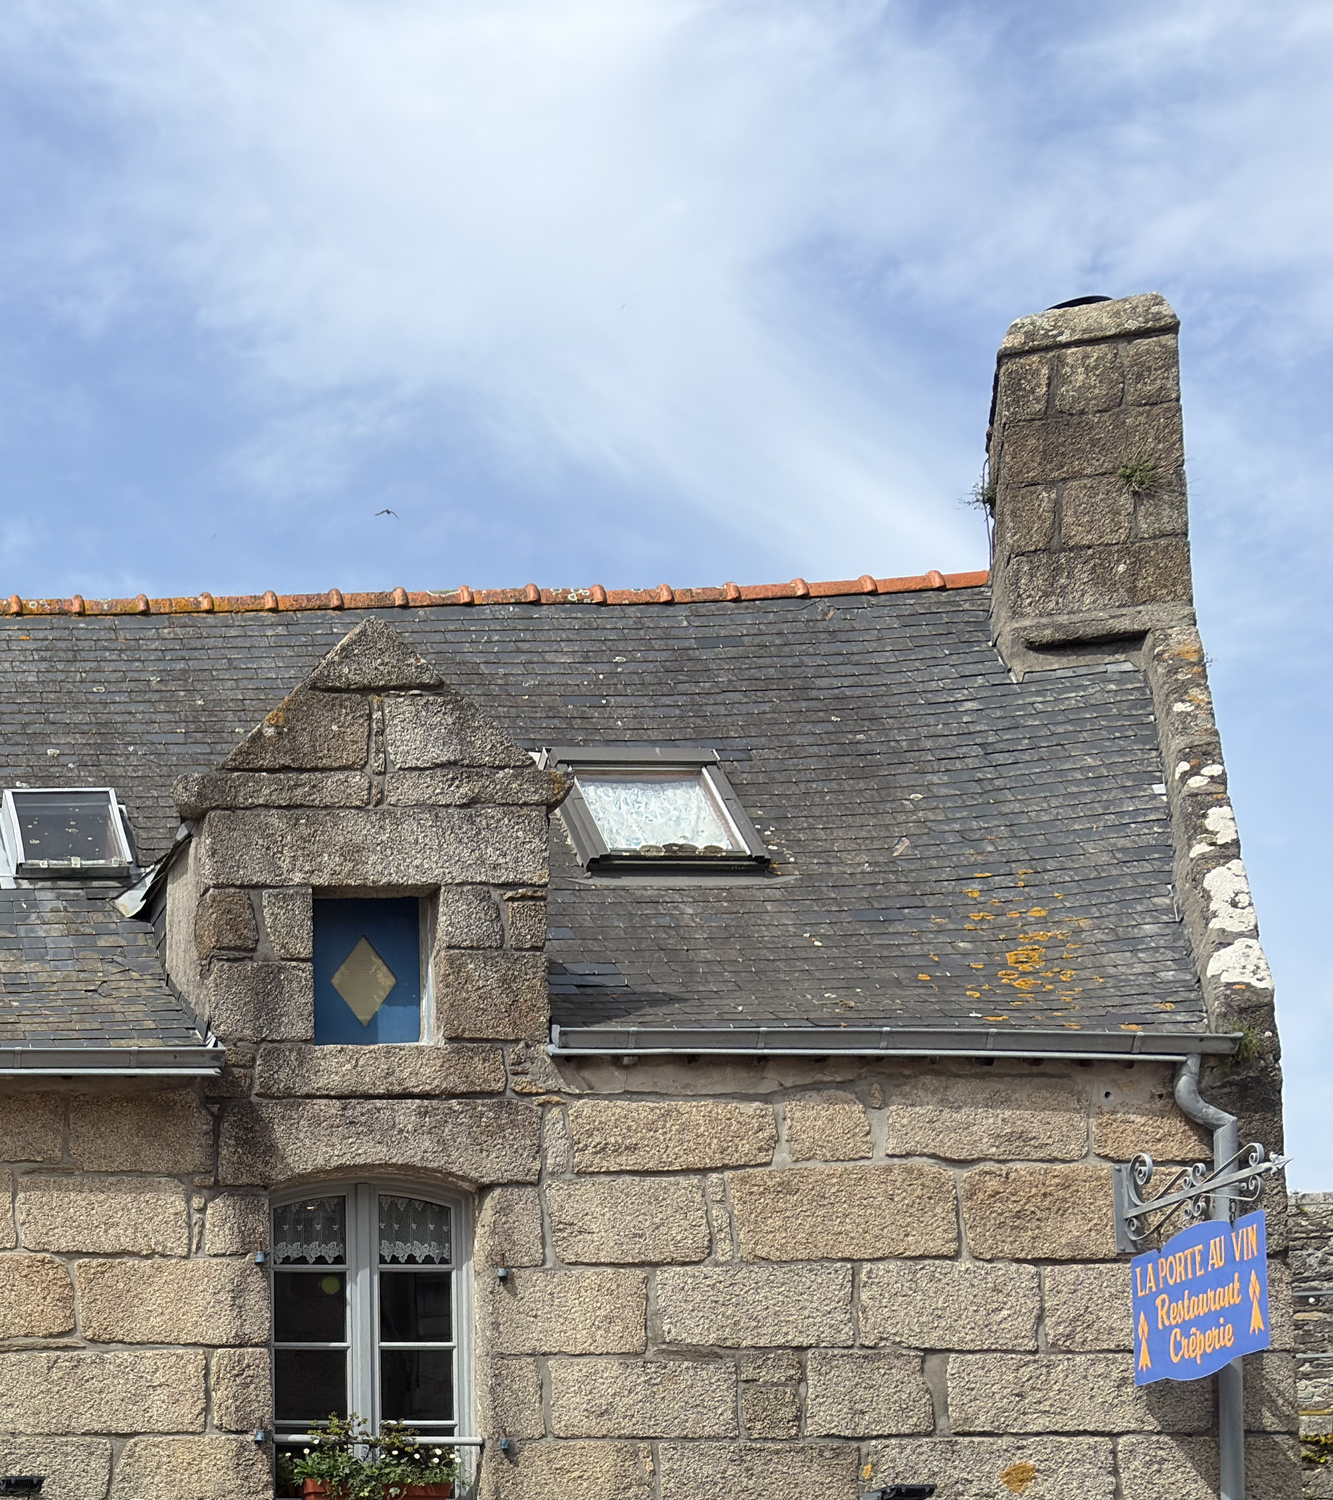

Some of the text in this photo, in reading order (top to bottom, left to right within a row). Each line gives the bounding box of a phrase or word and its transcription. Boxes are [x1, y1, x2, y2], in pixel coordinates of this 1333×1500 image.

[1135, 1224, 1258, 1297] LA PORTE AU VIN
[1155, 1272, 1242, 1330] Restaurant
[1170, 1317, 1235, 1365] Crêperie
